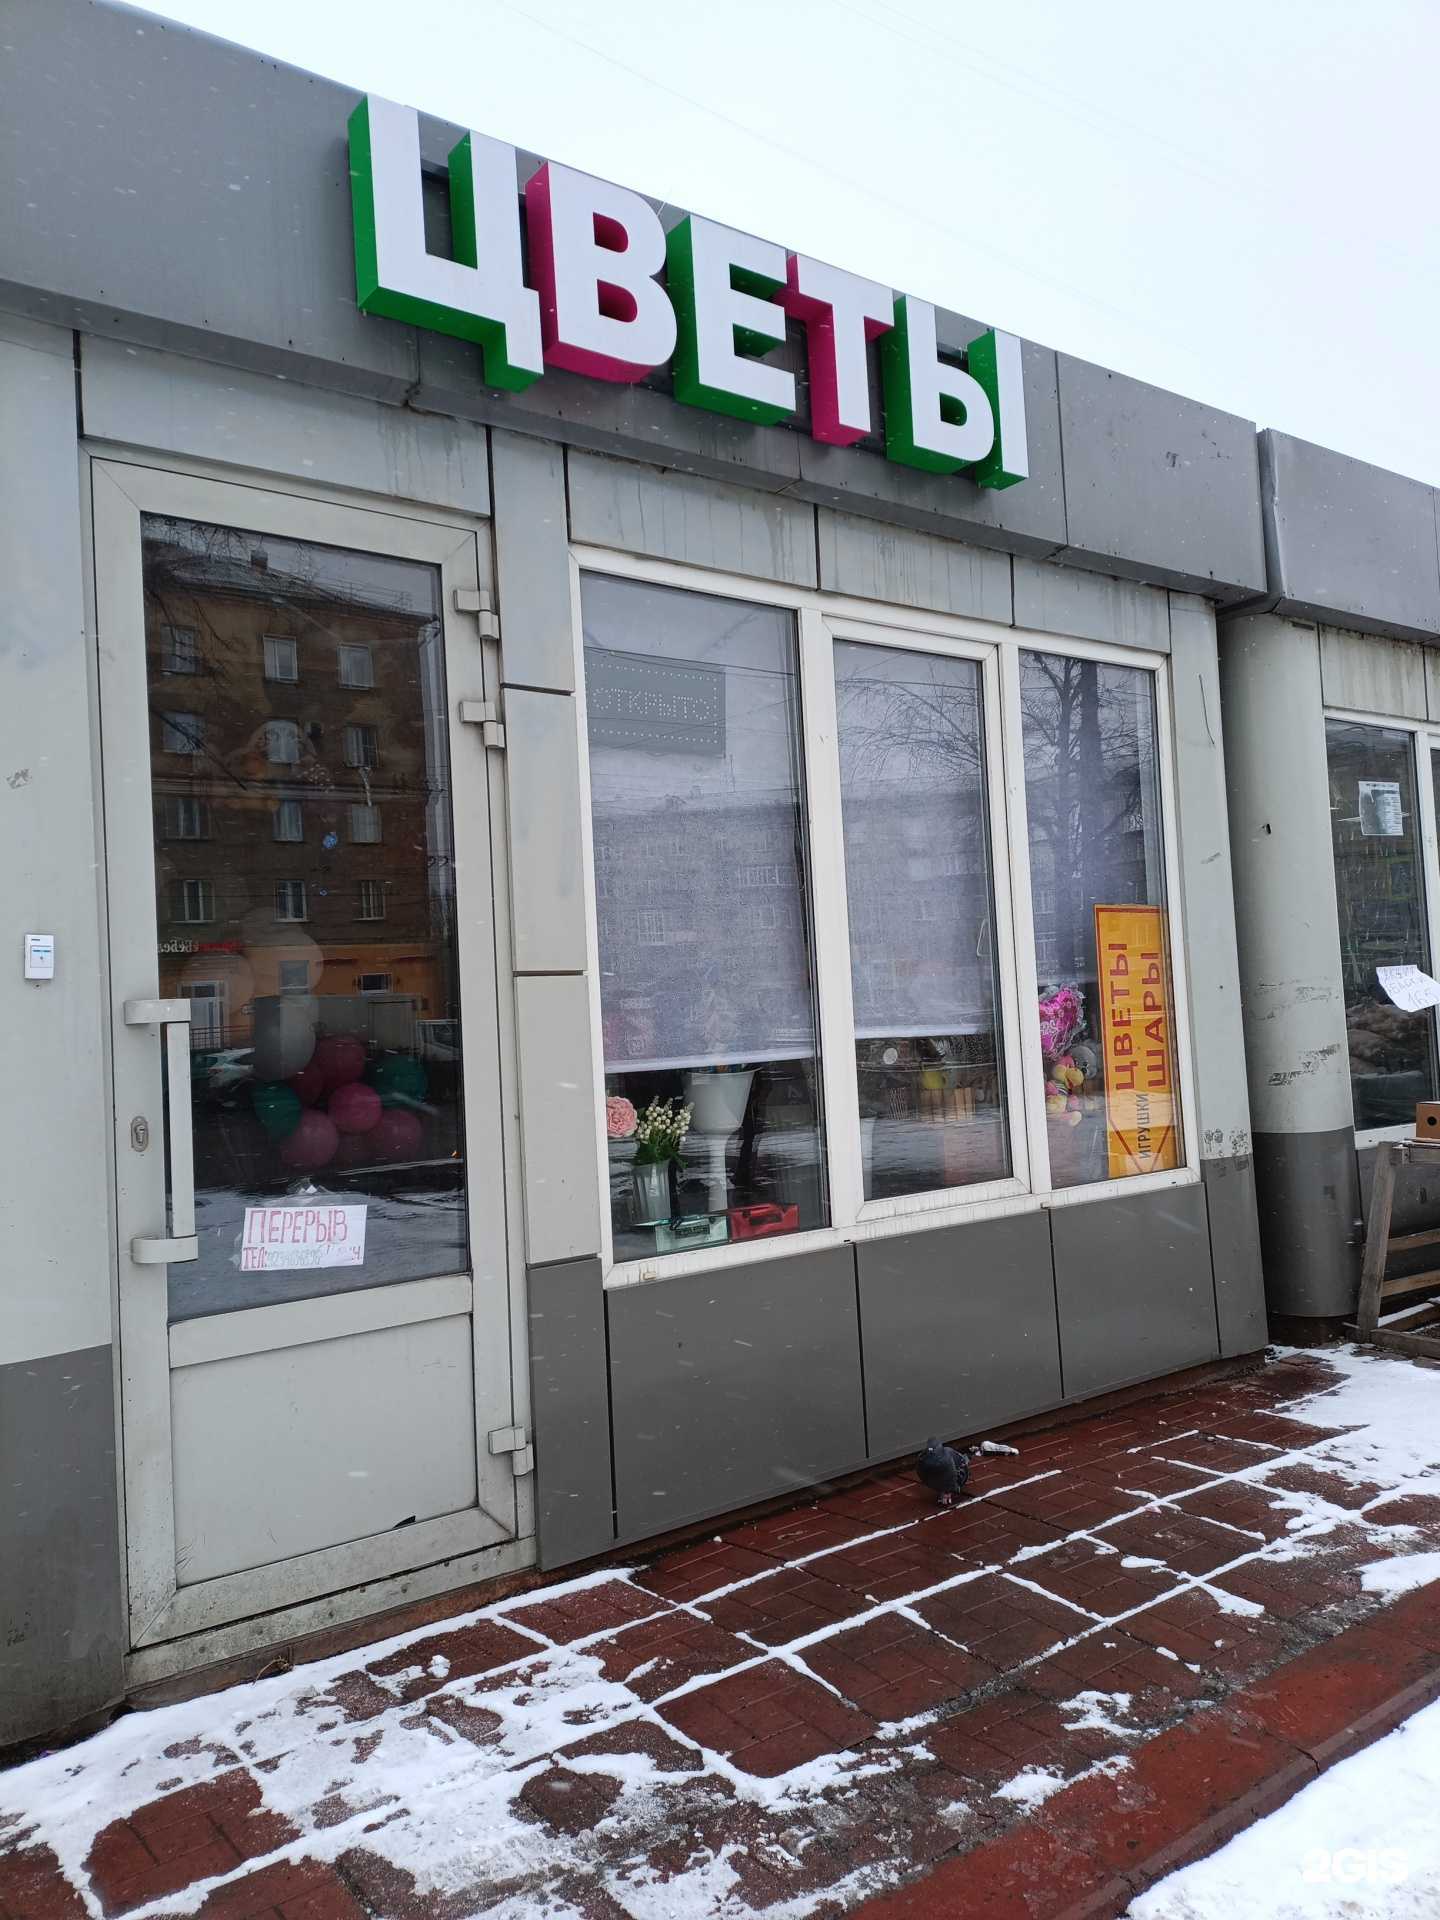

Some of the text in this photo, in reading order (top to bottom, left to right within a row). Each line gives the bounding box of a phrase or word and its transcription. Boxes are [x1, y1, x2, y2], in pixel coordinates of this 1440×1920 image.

[350, 91, 1030, 486] ЦВЕТЫ
[592, 687, 710, 721] ОТКРЫТО
[1108, 943, 1138, 1090] ЦВЕТЫ
[1141, 952, 1168, 1088] ШАРЫ
[1135, 1093, 1149, 1159] ИГРУШКИ
[247, 1209, 349, 1245] ПЕРЕРЫВ
